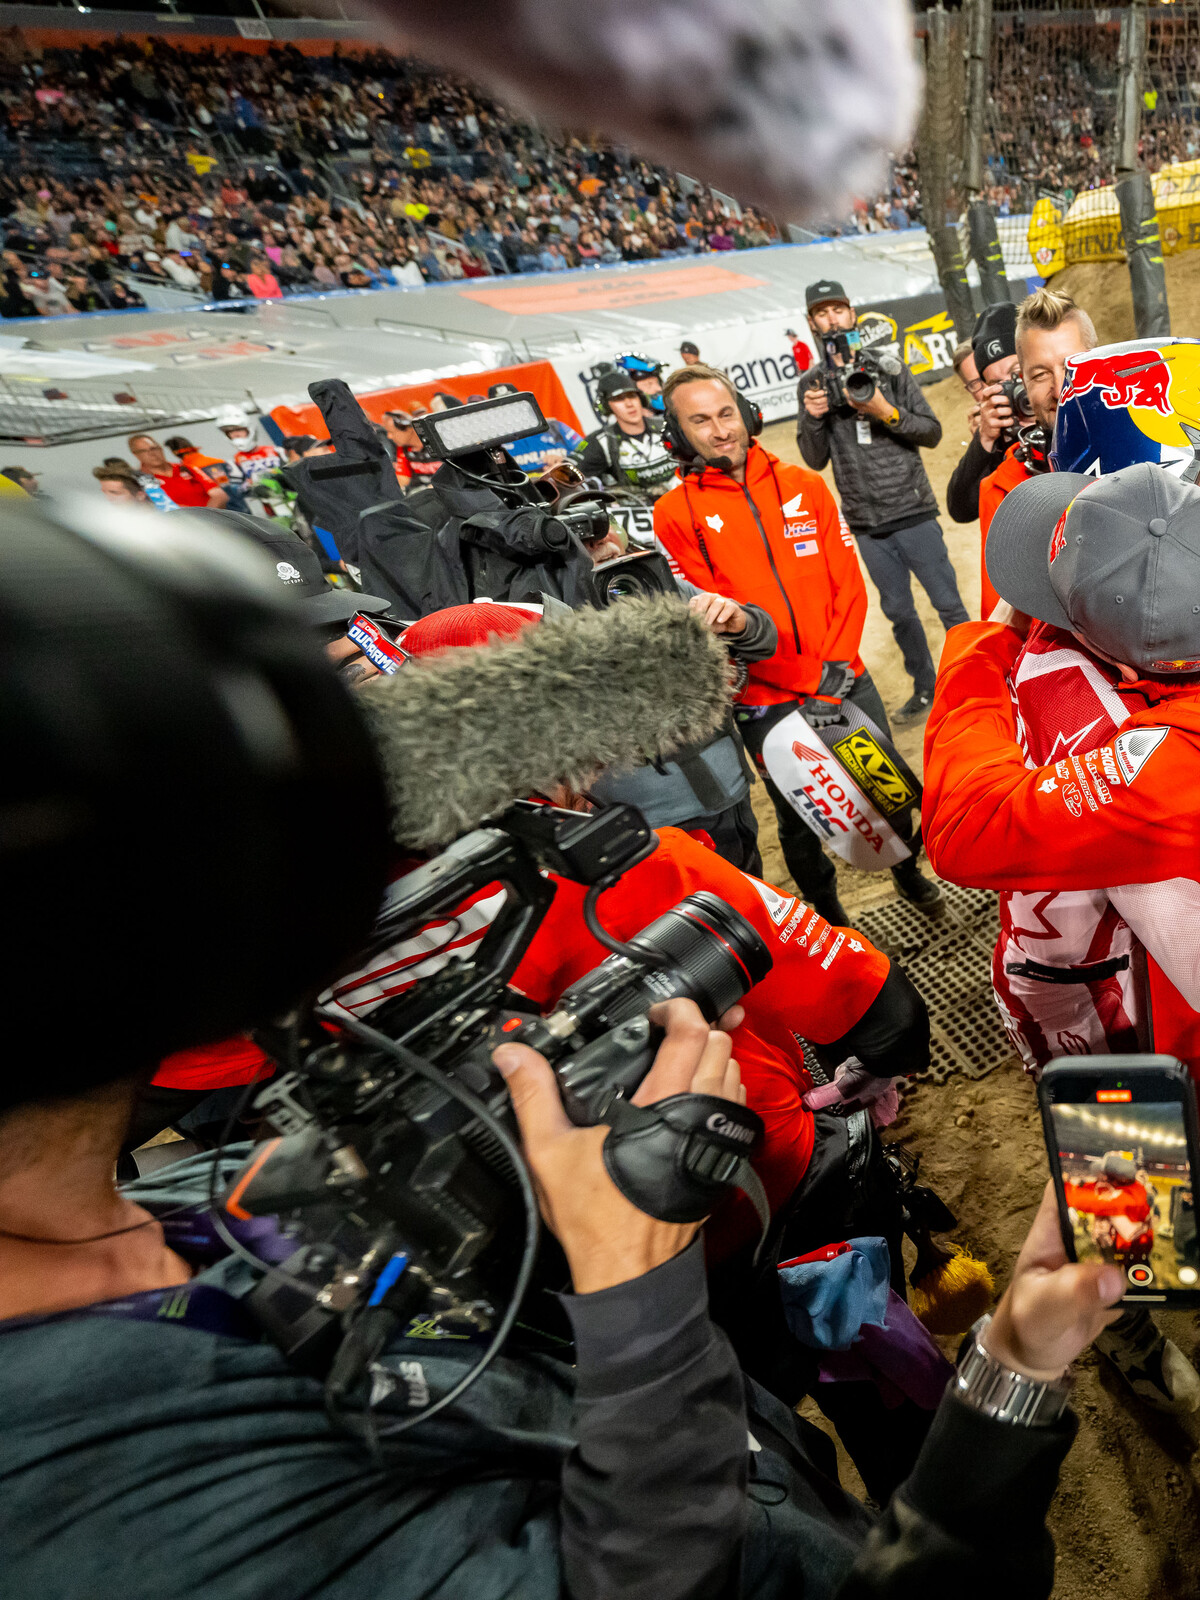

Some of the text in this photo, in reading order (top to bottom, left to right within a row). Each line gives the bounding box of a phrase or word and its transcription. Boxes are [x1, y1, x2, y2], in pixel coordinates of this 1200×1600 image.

[837, 743, 895, 813] MECHANIX WEAR
[1100, 746, 1121, 785] SHOWA
[809, 763, 884, 854] HONDA
[706, 1112, 755, 1144] Canon
